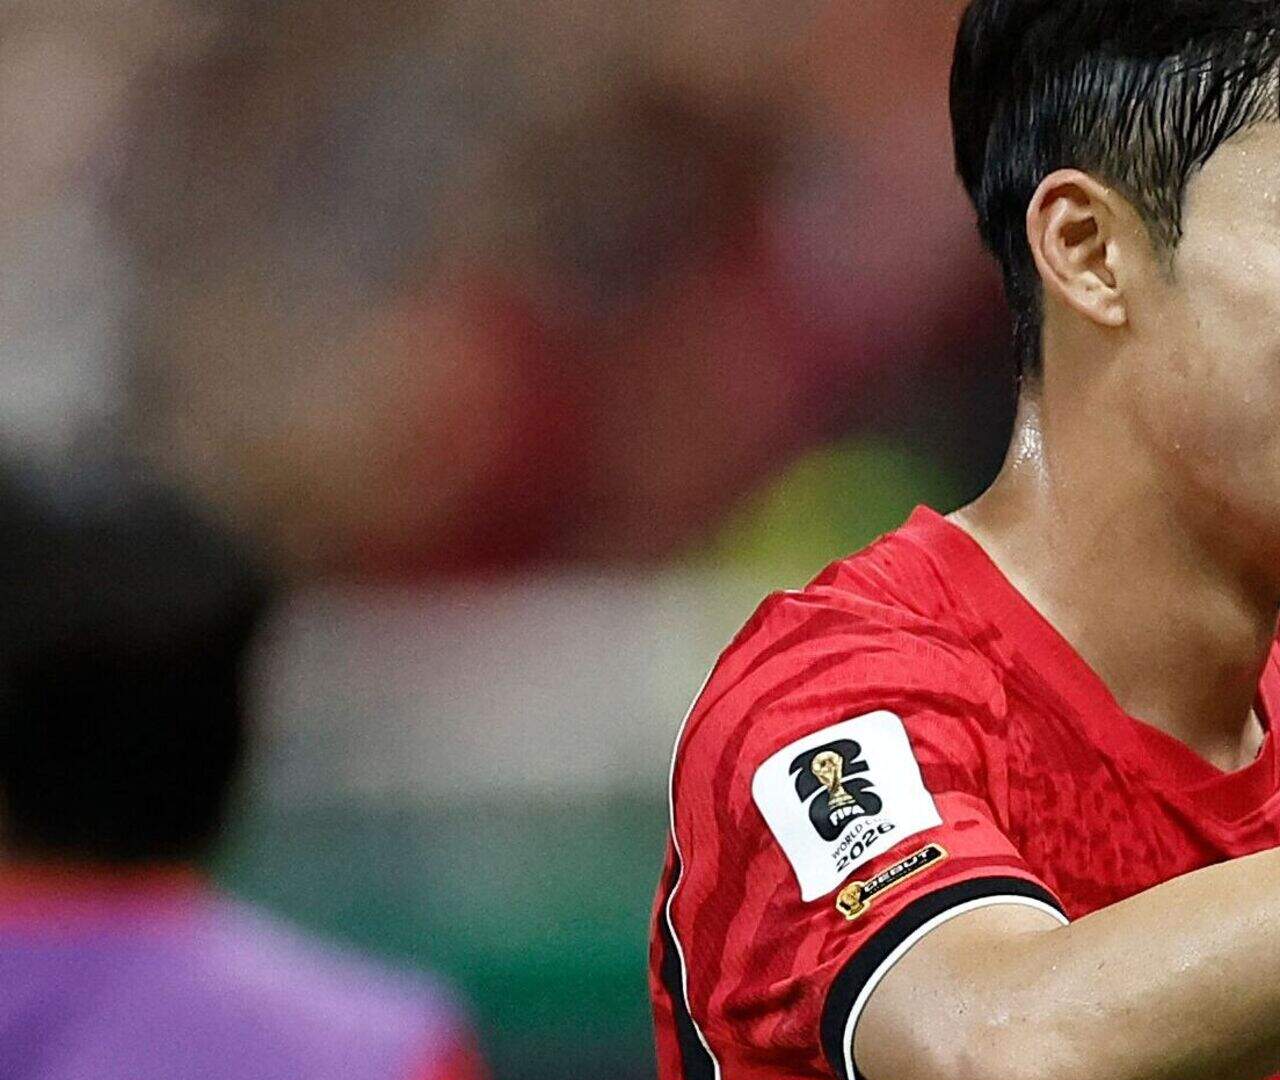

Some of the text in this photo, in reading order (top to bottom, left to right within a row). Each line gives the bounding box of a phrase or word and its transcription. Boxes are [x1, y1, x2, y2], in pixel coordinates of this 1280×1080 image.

[829, 804, 865, 826] FIFA
[832, 823, 863, 859] WORLD
[836, 822, 896, 872] 2026
[864, 849, 930, 892] DEBUT
